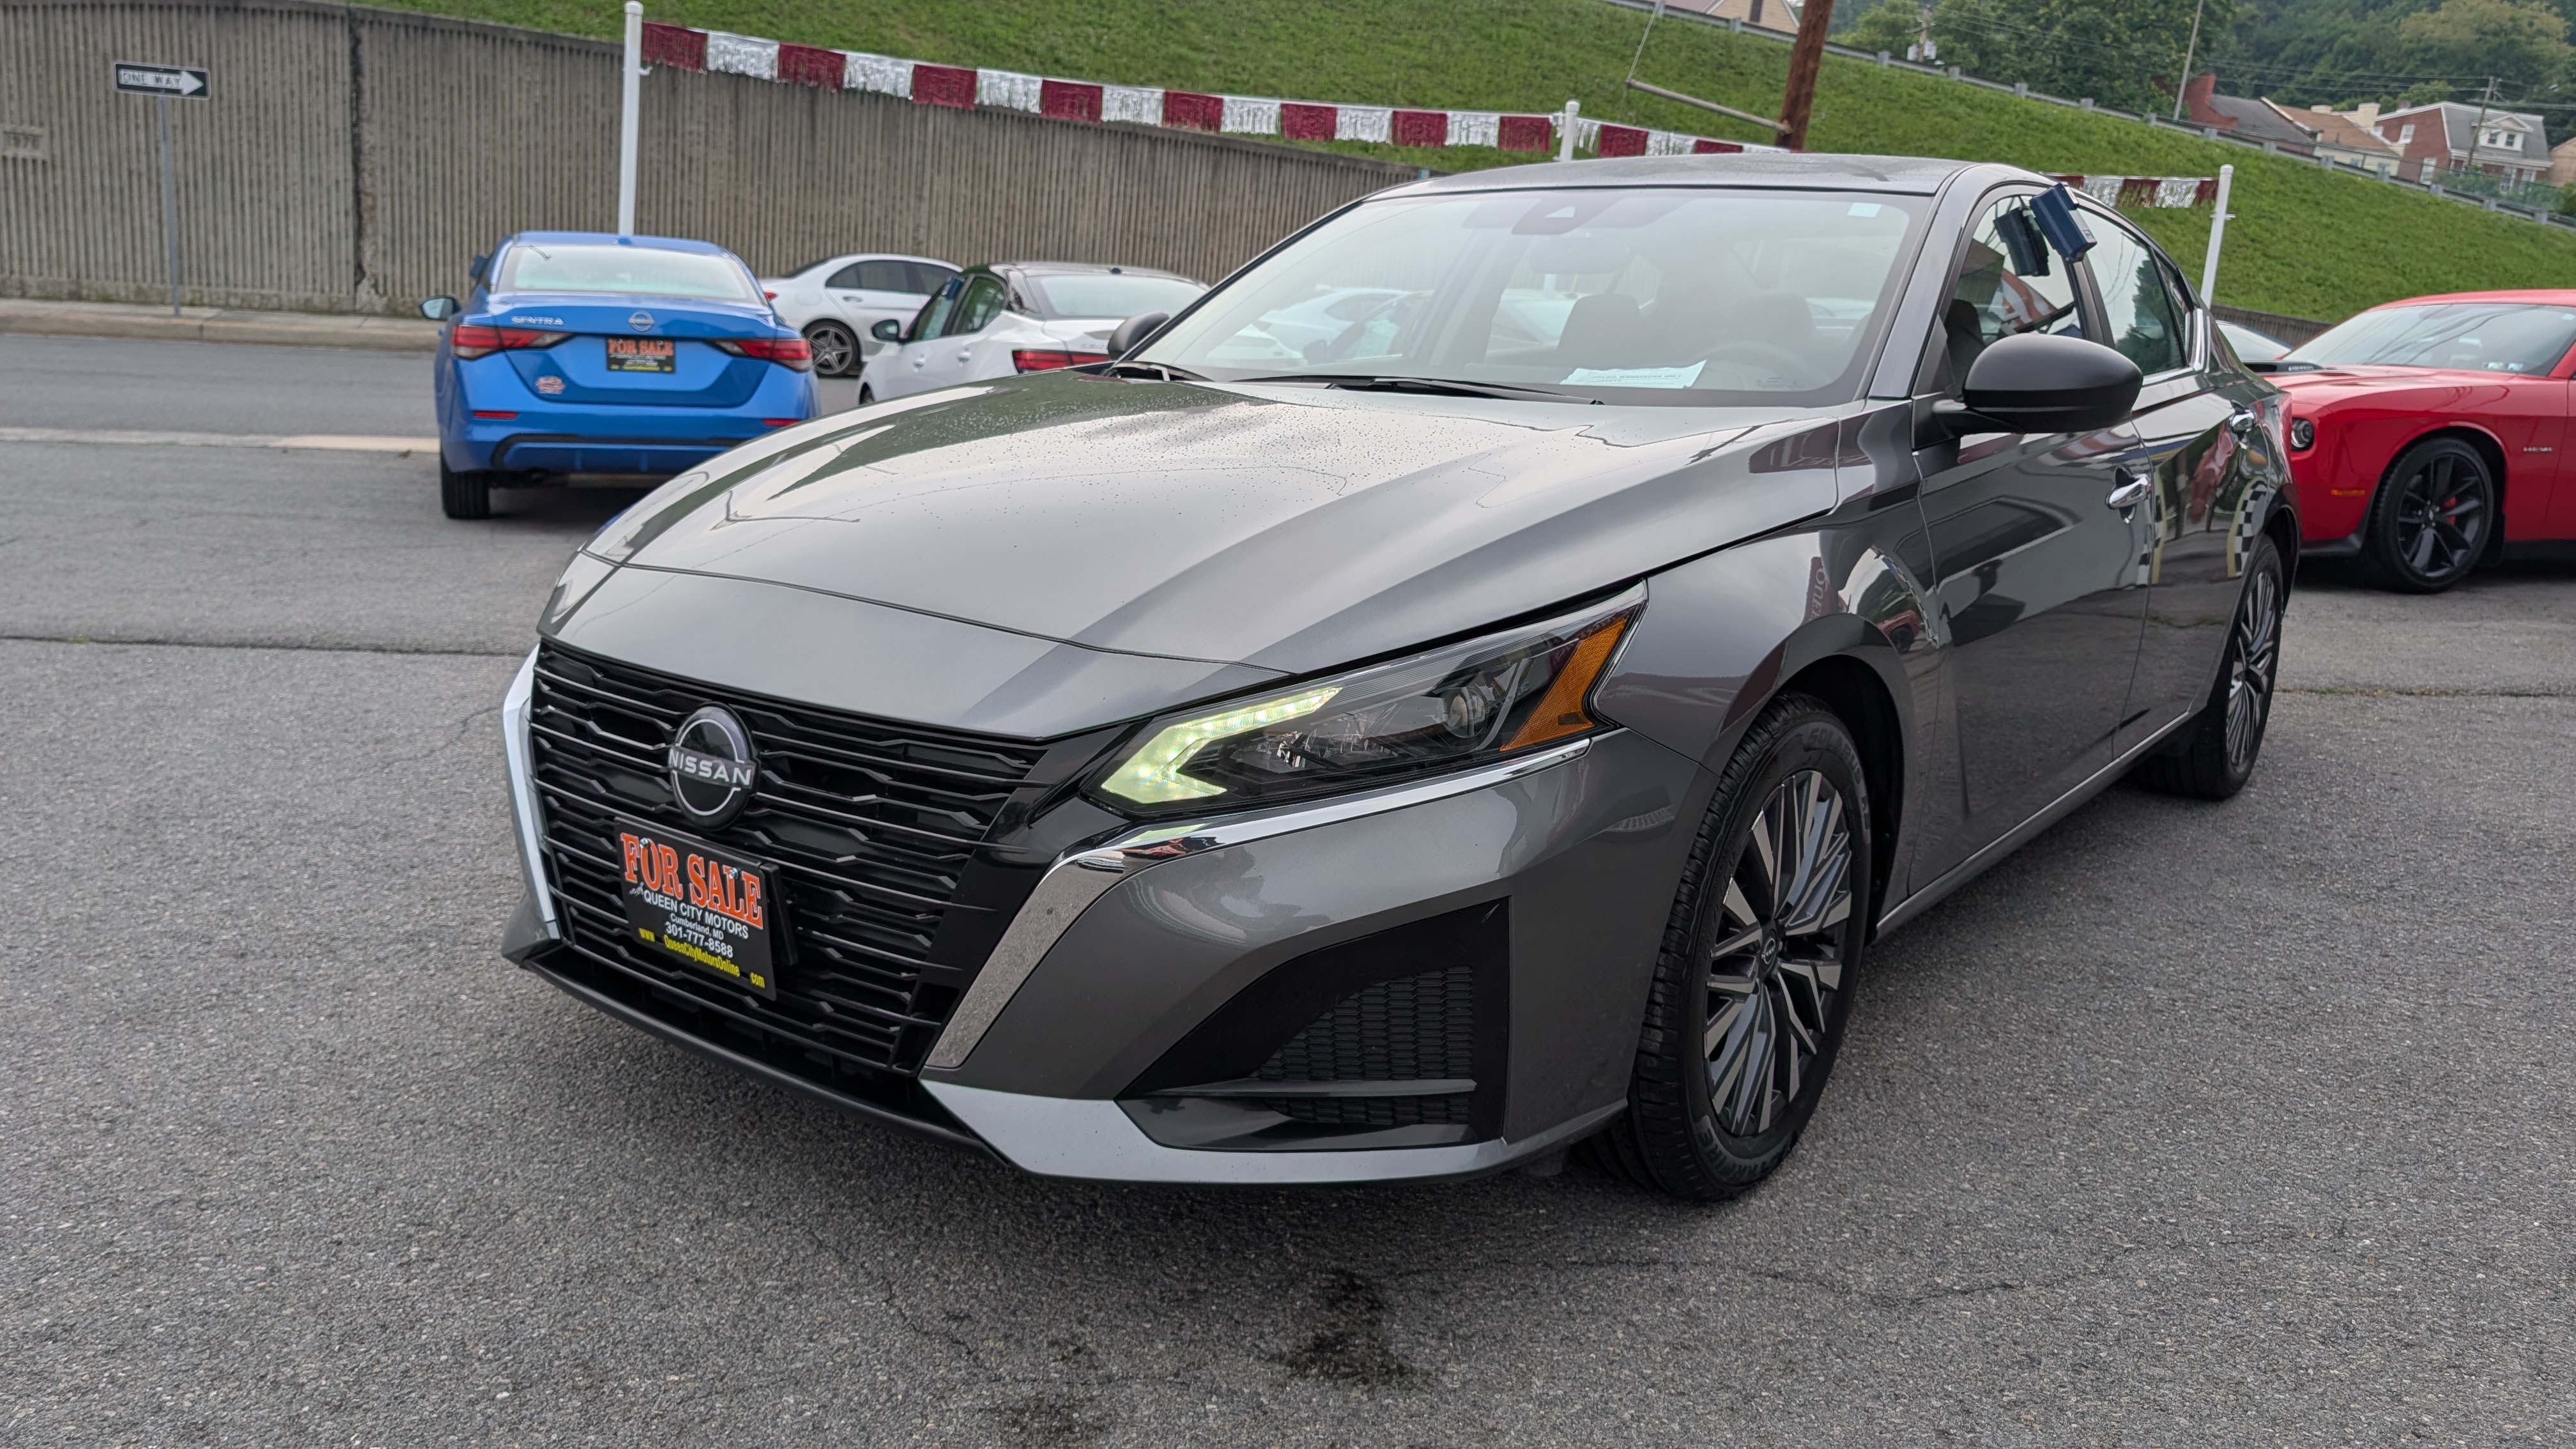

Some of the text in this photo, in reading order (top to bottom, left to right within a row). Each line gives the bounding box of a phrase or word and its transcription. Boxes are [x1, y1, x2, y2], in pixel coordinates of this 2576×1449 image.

[123, 72, 181, 88] ONE WAY
[511, 316, 564, 326] SENTRA
[608, 338, 673, 356] FOR SALE
[669, 748, 752, 786] NISSAN
[620, 832, 763, 930] FOR SALE
[643, 889, 749, 940] QUEEN CITY MOTORS
[670, 912, 724, 940] Cumberland, MD
[664, 921, 734, 958] 301-777-8588
[663, 934, 740, 977] QueenCityMotorsOnline
[749, 972, 766, 989] com
